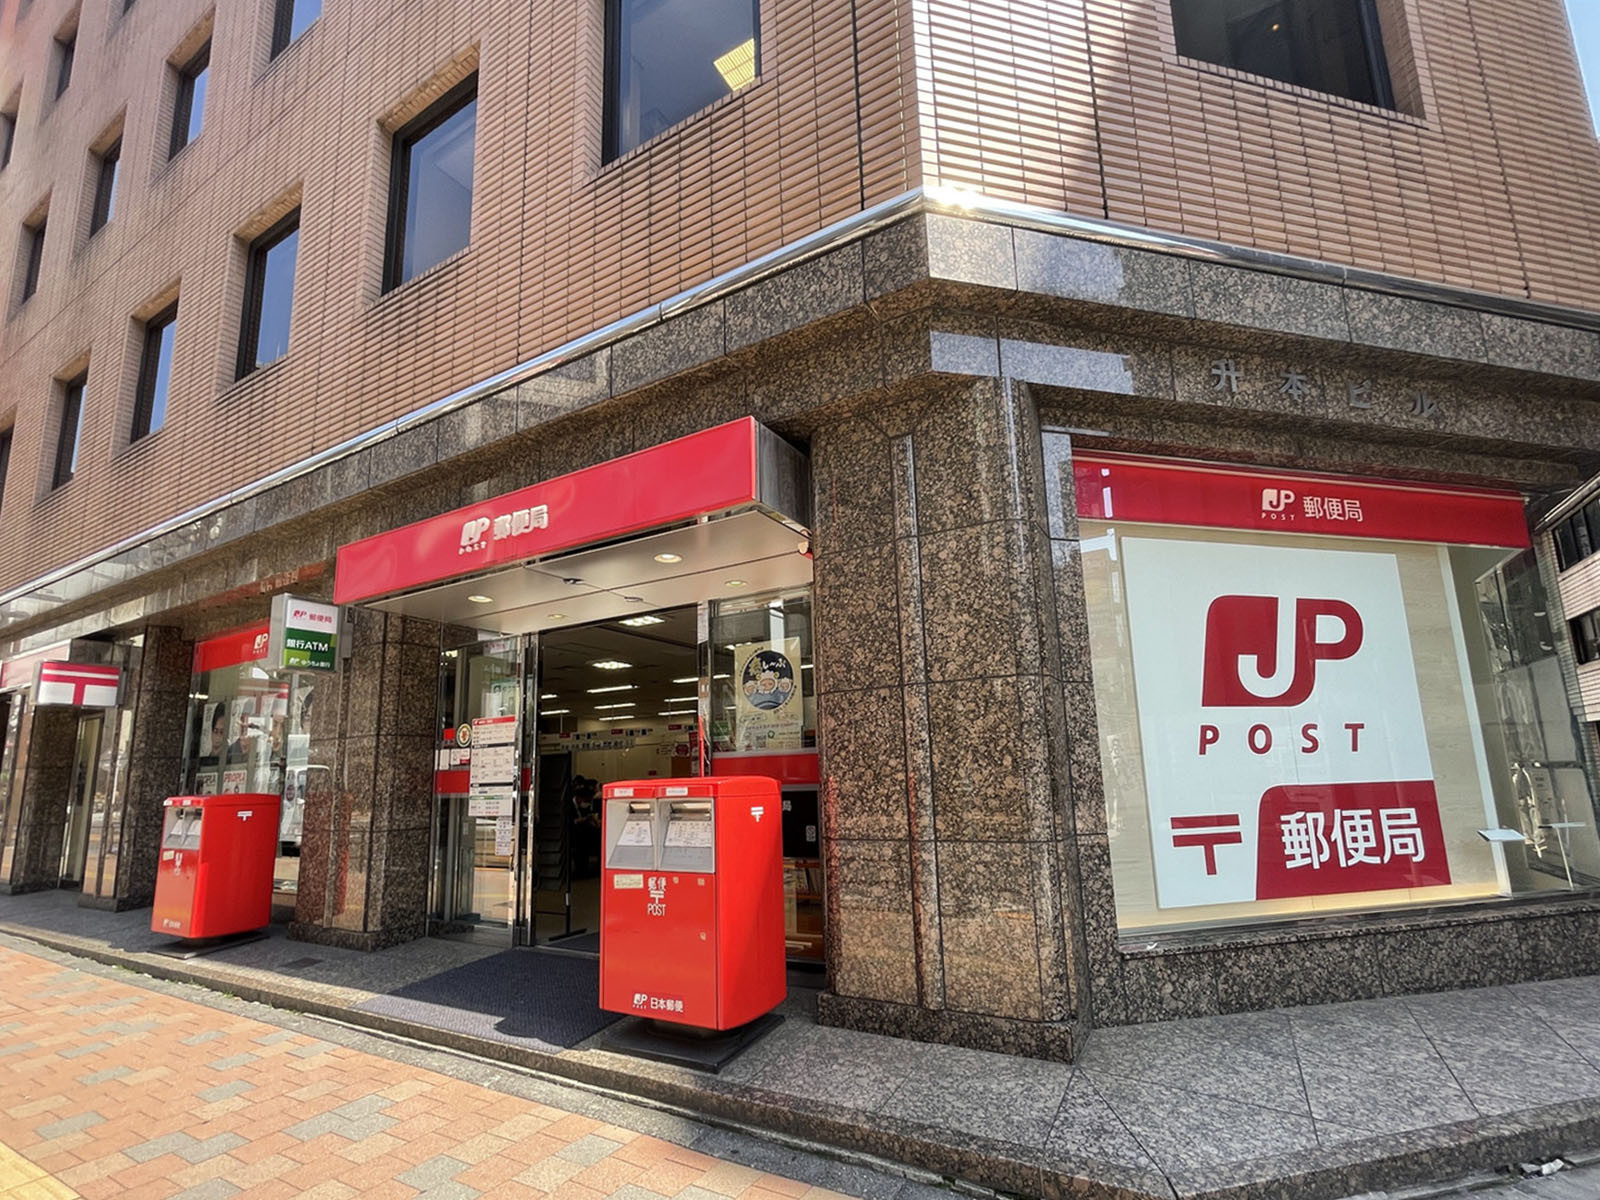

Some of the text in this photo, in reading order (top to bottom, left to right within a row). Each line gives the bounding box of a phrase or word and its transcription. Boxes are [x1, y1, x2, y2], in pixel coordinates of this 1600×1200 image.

[1210, 358, 1443, 418] 升本ビル
[493, 504, 549, 541] 郵便局
[1261, 512, 1295, 521] POST
[1303, 496, 1363, 522] 郵便局
[286, 638, 328, 652] 銀行ATM
[1201, 594, 1364, 707] JP
[1198, 722, 1365, 755] POST
[1280, 807, 1425, 869] 郵便局
[647, 903, 667, 917] POST
